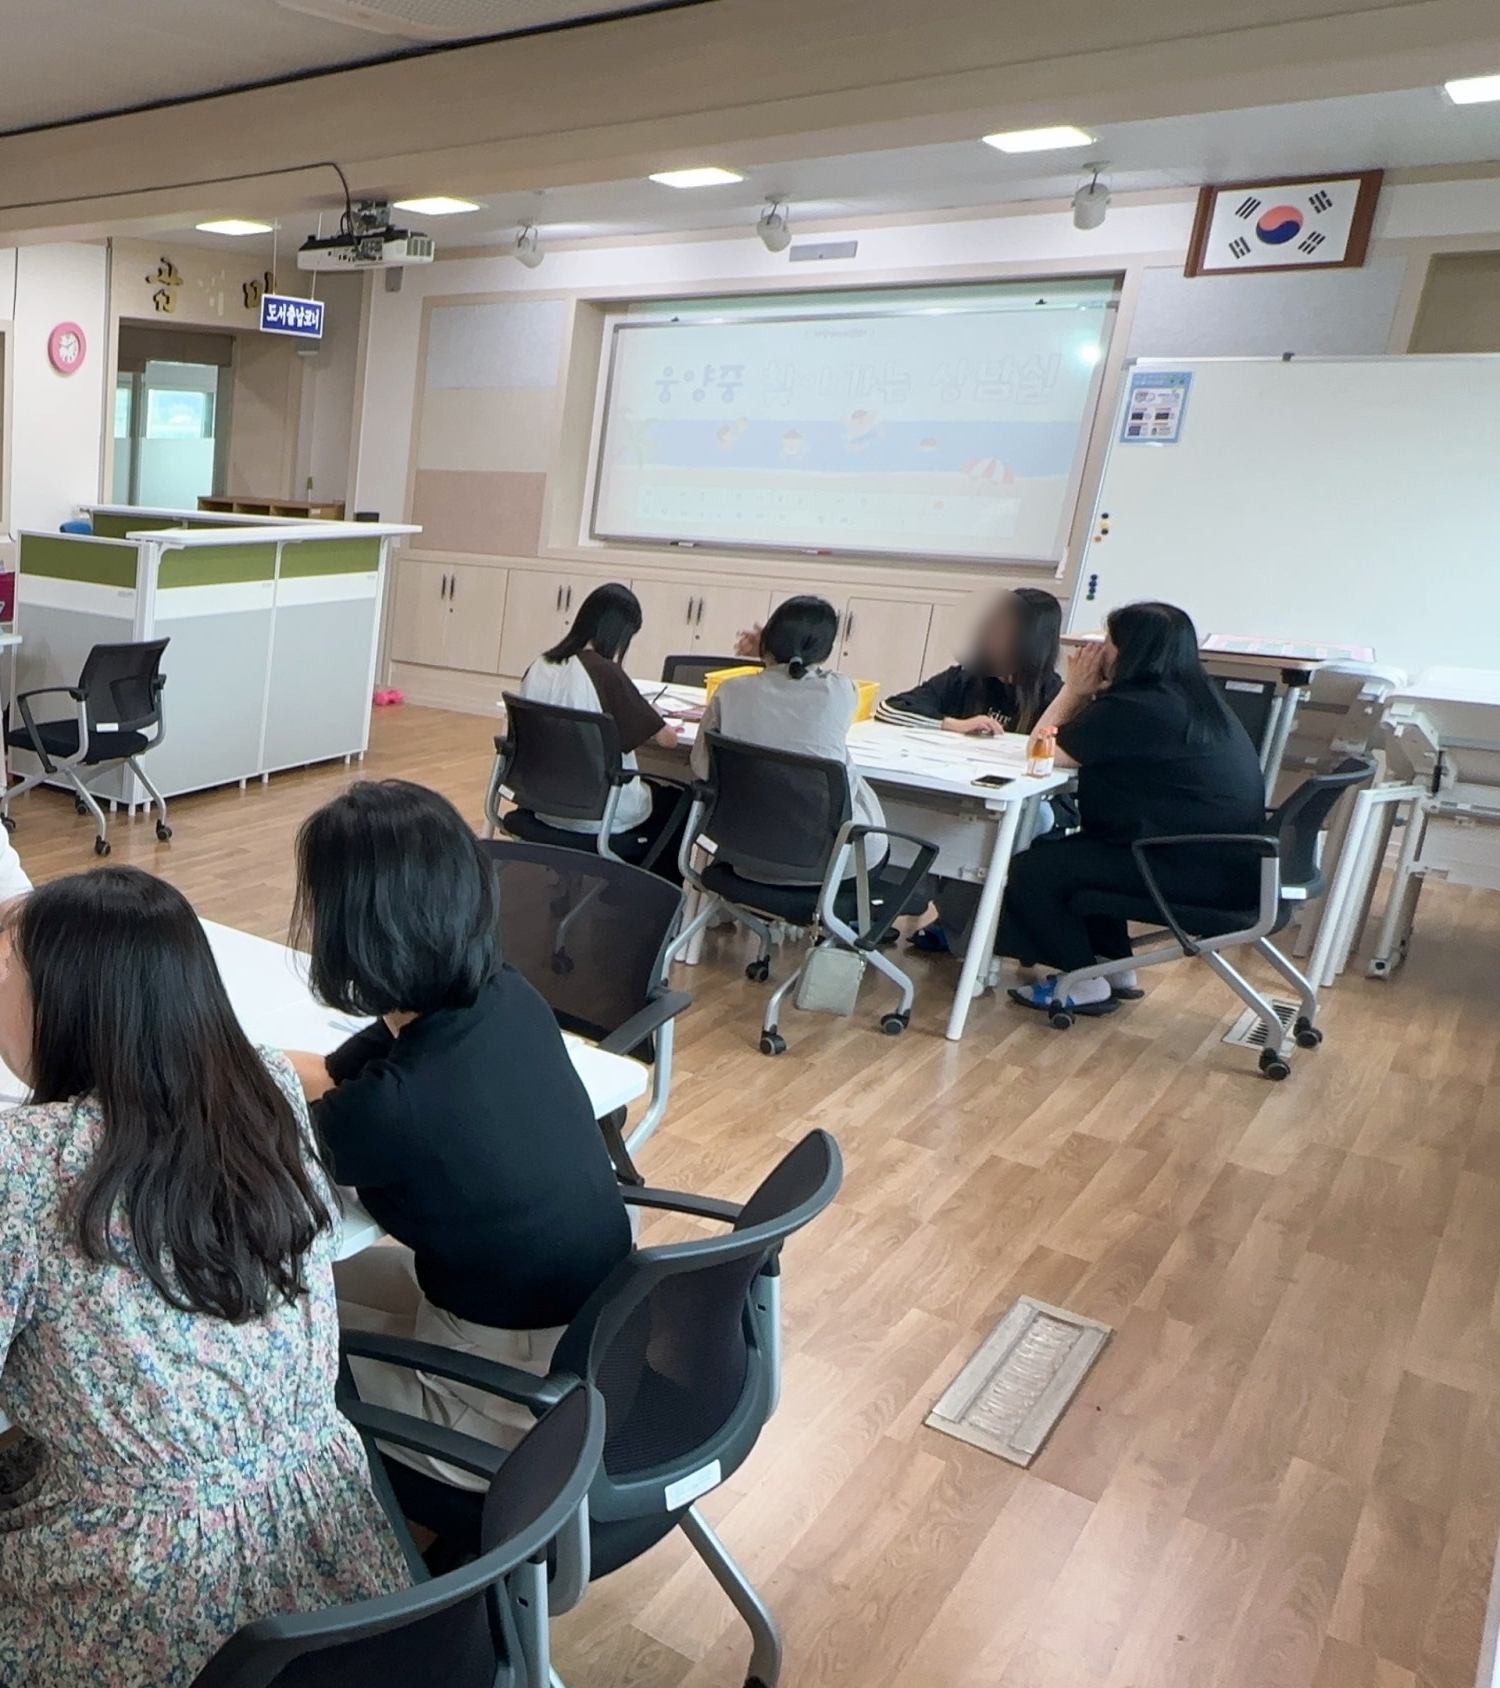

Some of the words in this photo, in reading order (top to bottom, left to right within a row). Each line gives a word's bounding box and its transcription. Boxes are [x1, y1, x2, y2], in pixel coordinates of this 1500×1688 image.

[266, 303, 320, 331] 도서출납코너
[653, 362, 747, 405] 웅양중
[760, 358, 913, 408] 찾아가는
[928, 351, 1062, 406] 상담실
